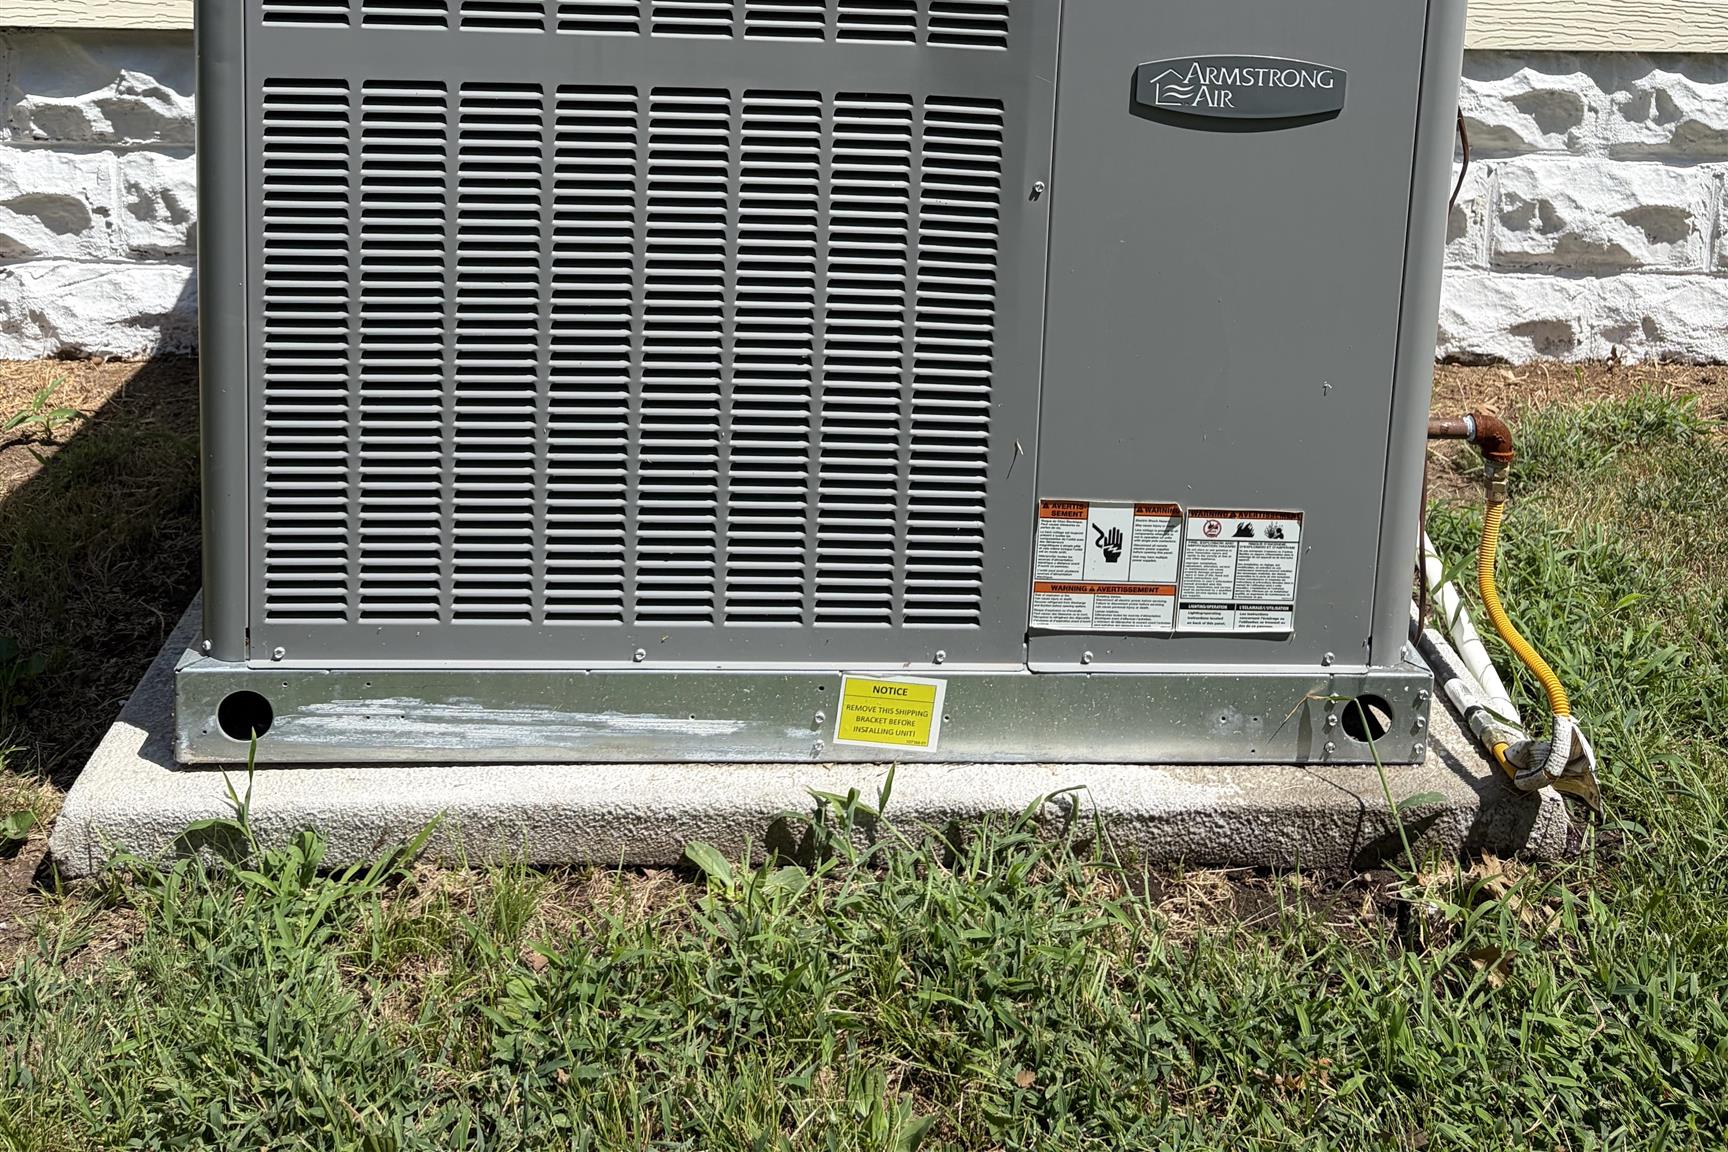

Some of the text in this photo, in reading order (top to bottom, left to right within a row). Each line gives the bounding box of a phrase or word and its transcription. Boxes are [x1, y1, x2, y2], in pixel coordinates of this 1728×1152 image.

[1182, 62, 1334, 88] ARMSTRONG
[1192, 84, 1234, 108] AIR
[1051, 584, 1087, 592] WARNING
[872, 685, 908, 696] NOTICE
[846, 704, 929, 718] REMOVE THIS SHIPPING
[856, 715, 916, 727] BRACKET BEFORE
[853, 726, 916, 737] INSTALLING UNIT!
